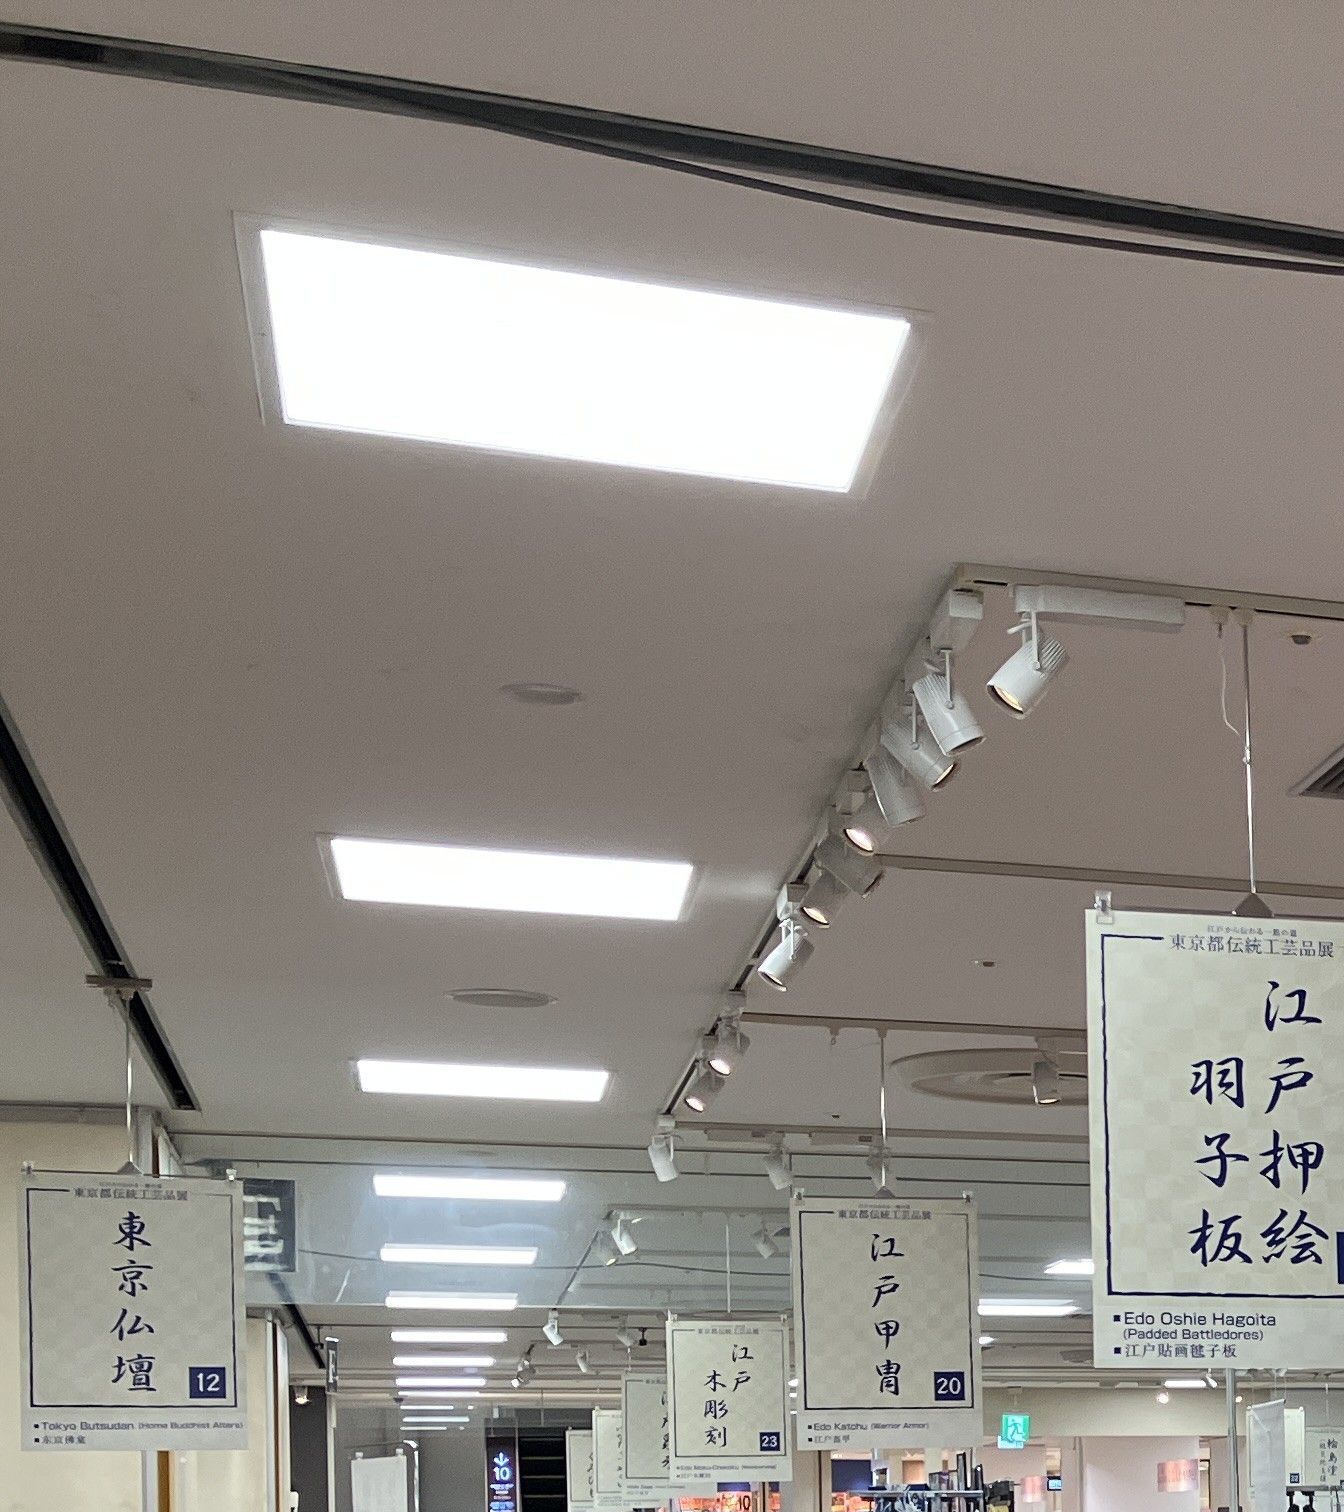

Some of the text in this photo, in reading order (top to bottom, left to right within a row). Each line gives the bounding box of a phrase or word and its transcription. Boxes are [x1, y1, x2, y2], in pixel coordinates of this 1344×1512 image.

[1170, 934, 1334, 958] 東京都伝統工芸品展
[1259, 981, 1329, 1265] 江戸押絵
[1188, 1057, 1253, 1267] 羽子板
[110, 1211, 156, 1393] 東京仏壇
[871, 1234, 905, 1396] 江戸甲冑
[1124, 1312, 1276, 1328] Edo Oshie Hagoita
[1123, 1329, 1263, 1341] (Padded Battledores)
[732, 1344, 754, 1392] 江戸
[197, 1374, 220, 1392] 12
[937, 1377, 961, 1395] 20
[703, 1369, 729, 1448] 木彫刻
[761, 1435, 778, 1448] 23
[493, 1467, 511, 1481] 10
